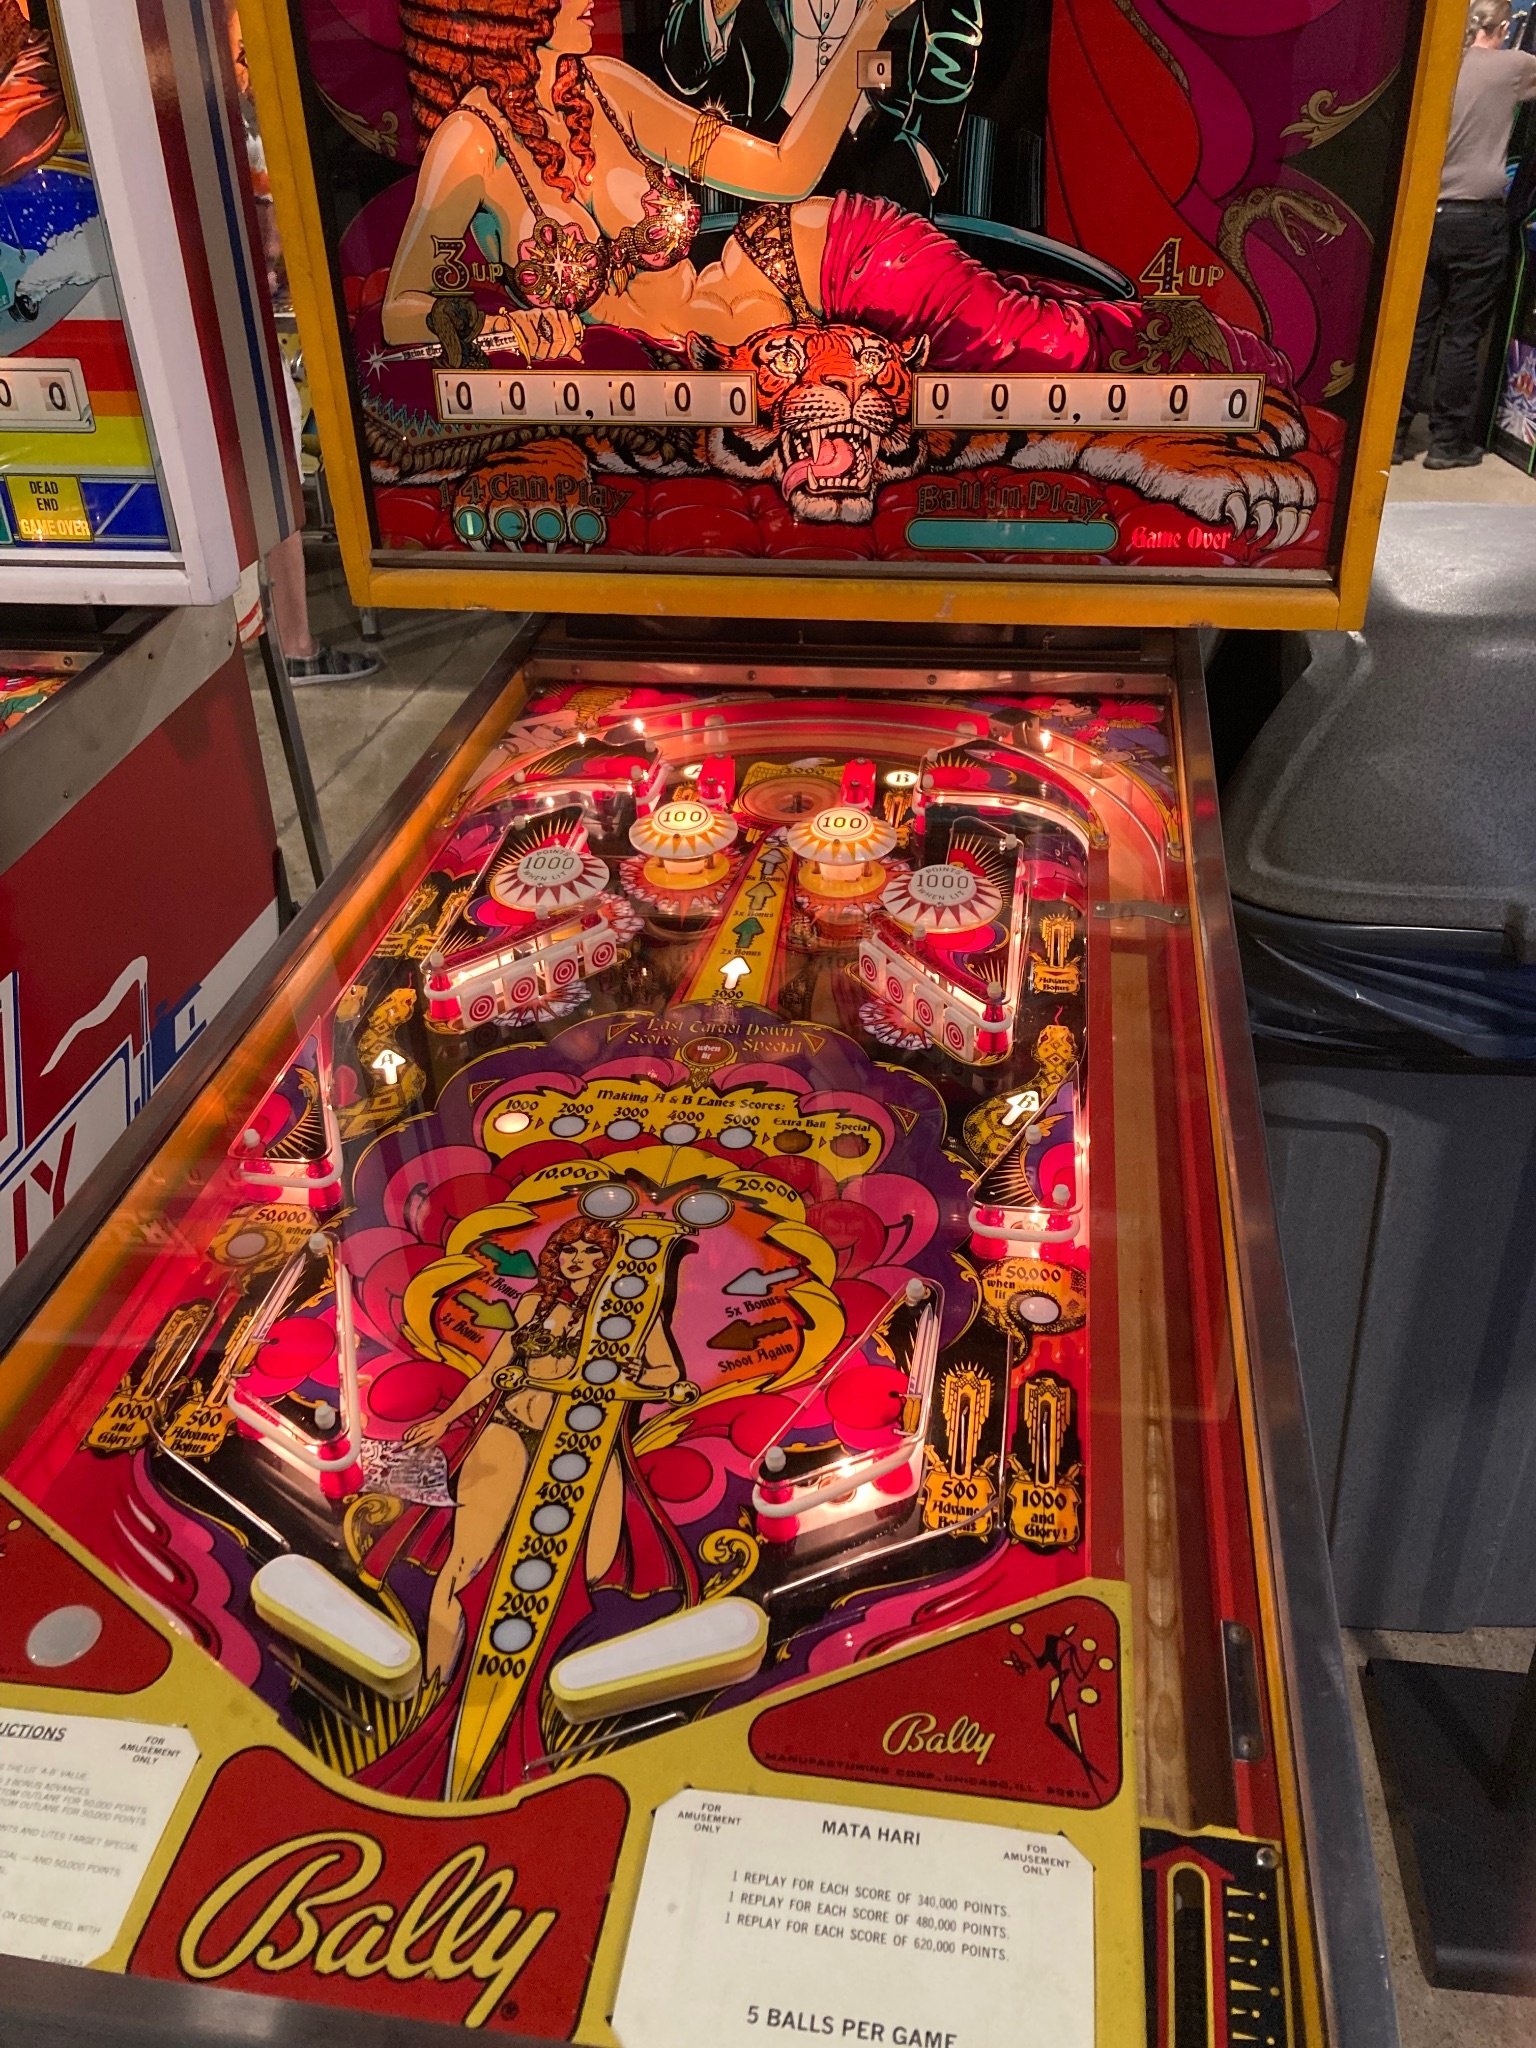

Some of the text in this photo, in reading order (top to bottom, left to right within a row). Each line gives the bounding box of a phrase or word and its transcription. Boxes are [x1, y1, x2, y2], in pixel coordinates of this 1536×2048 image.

[877, 63, 885, 75] 0
[431, 235, 470, 291] 3
[1139, 237, 1224, 295] 4 UP
[29, 481, 59, 494] DEAD
[37, 498, 59, 511] END
[917, 476, 1103, 525] Ball in Play
[20, 518, 91, 536] GAME OVER
[1132, 525, 1231, 549] Game Over
[663, 811, 702, 822] 100
[823, 816, 863, 829] 100
[536, 849, 571, 857] POINTS
[522, 856, 576, 870] 1000
[925, 867, 962, 875] POINTS
[523, 870, 567, 881] WHEN LIT
[917, 874, 969, 889] 1000
[918, 888, 965, 901] WHEN LIT
[712, 989, 744, 999] 3000
[628, 1032, 679, 1045] Scores
[597, 1089, 648, 1103] Making
[671, 1095, 678, 1104] &
[683, 1094, 692, 1104] B
[698, 1096, 737, 1108] Lanes
[740, 1099, 785, 1111] Scores:
[1018, 1094, 1036, 1109] B
[506, 1100, 871, 1132] 1000 2000 3000 4000 5000 Extra Ball Special
[534, 1166, 599, 1182] 10,000
[735, 1178, 799, 1203] 20,000
[255, 1208, 307, 1224] 50,000
[285, 1226, 312, 1235] when
[617, 1260, 658, 1275] 9000
[1005, 1265, 1062, 1283] 50,000
[478, 1272, 522, 1300] 2x Bonus
[987, 1279, 1016, 1289] when
[600, 1298, 645, 1315] 8000
[725, 1296, 782, 1318] 5x Bonus
[452, 1318, 485, 1344] Bonus
[589, 1340, 630, 1356] 7000
[718, 1344, 795, 1373] Shoot Again
[571, 1386, 616, 1403] 6000
[111, 1402, 152, 1420] 1000
[110, 1422, 135, 1433] and
[186, 1411, 223, 1428] 500
[171, 1426, 221, 1442] Advance
[555, 1432, 602, 1451] 5000
[170, 1440, 207, 1453] Bonus
[535, 1482, 585, 1502] 4000
[941, 1481, 978, 1501] 500
[1023, 1490, 1067, 1511] 1000
[1031, 1513, 1055, 1525] and
[518, 1535, 568, 1556] 3000
[497, 1592, 549, 1615] 2000
[477, 1654, 527, 1679] 1000
[145, 1736, 165, 1745] FOR
[882, 1712, 996, 1766] Bally
[120, 1743, 181, 1758] AMUSEMENT
[132, 1755, 159, 1765] ONLY
[701, 1803, 722, 1812] FOR
[677, 1811, 742, 1826] AMUSEMENT
[694, 1824, 721, 1834] ONLY
[822, 1820, 920, 1846] MATA HARI
[1026, 1844, 1048, 1854] FOR
[1003, 1852, 1071, 1868] AMUSEMENT
[1022, 1865, 1051, 1876] ONLY
[733, 1870, 1011, 1918] 1 REPLAY FOR EACH SCORE OF 340,000 POINTS.
[729, 1891, 1010, 1940] 1 REPLAY FOR EACH SCORE OF 480,000 POINTS.
[18, 1913, 50, 1927] SCORE
[51, 1919, 73, 1931] REEL
[77, 1923, 102, 1935] WITH
[178, 1828, 561, 2030] Bally
[725, 1912, 1010, 1962] 1 REPLAY FOR EACH SCORE OF 620,000 POINTS.
[747, 2005, 759, 2024] 5
[766, 2007, 834, 2035] BALLS
[841, 2018, 885, 2042] PER
